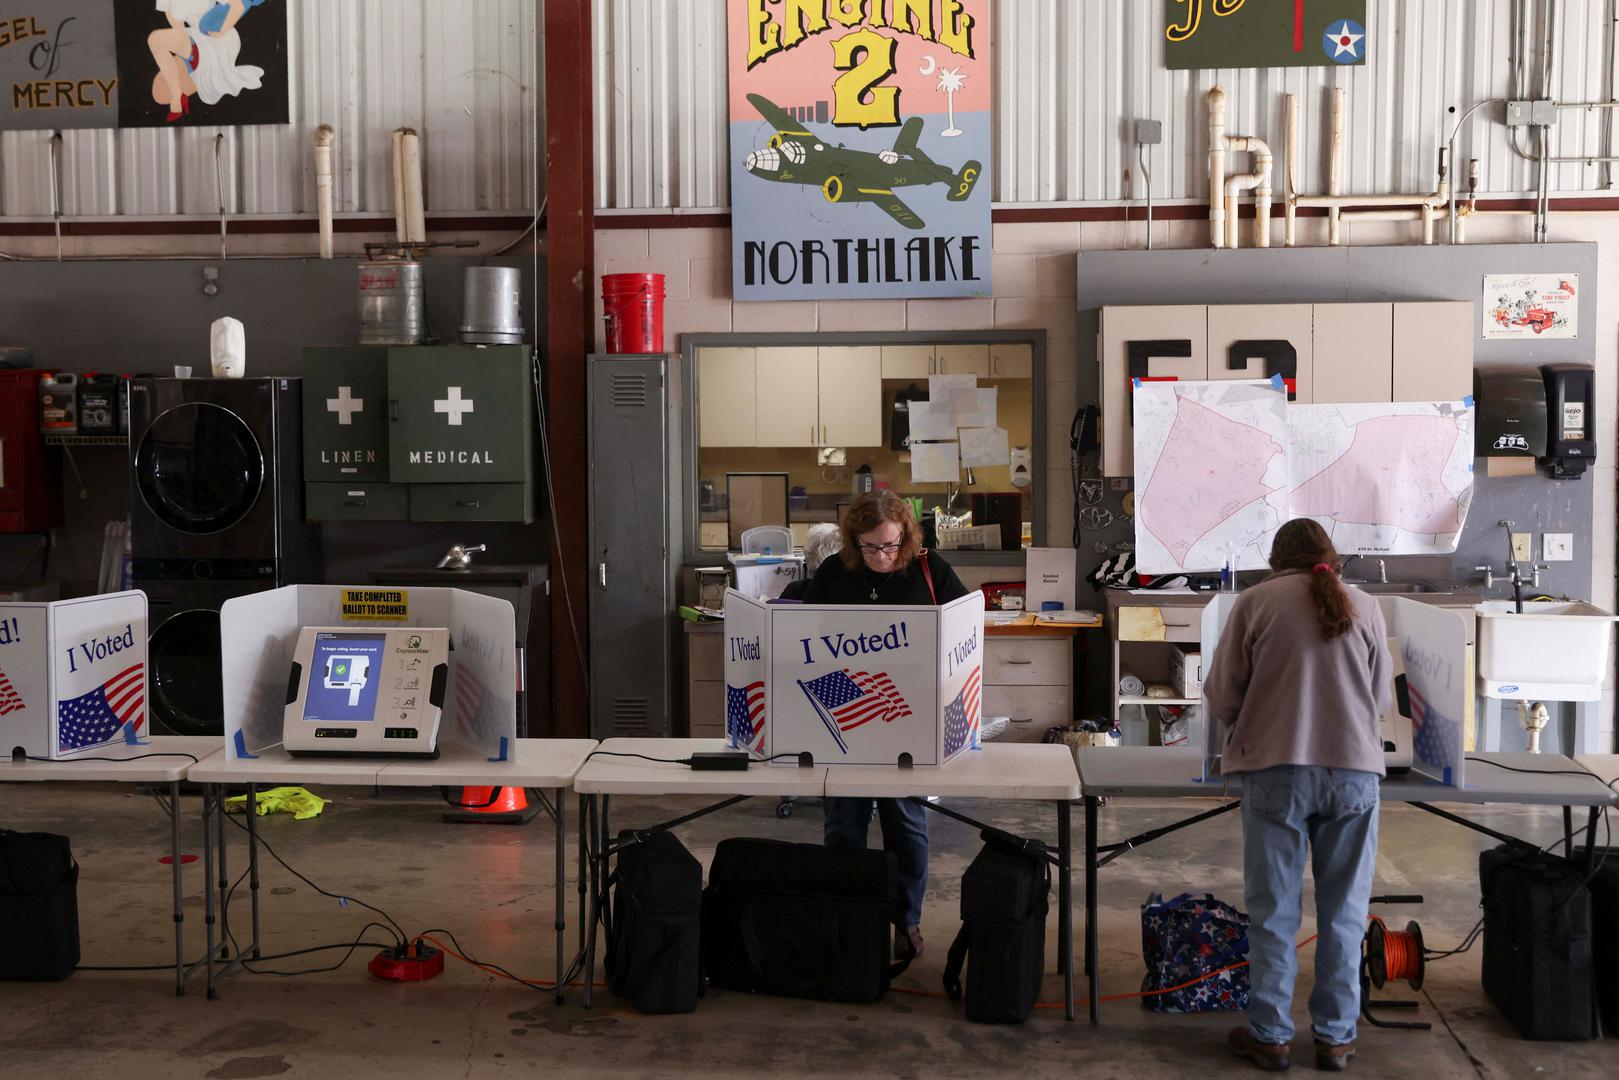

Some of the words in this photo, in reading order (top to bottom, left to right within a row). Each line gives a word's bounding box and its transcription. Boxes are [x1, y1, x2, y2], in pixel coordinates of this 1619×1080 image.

[29, 16, 77, 80] of
[747, 0, 976, 72] ENGINE
[12, 79, 117, 109] MERCY
[830, 27, 902, 131] 2
[743, 235, 982, 286] NORTHLAKE
[321, 450, 376, 463] LINEN
[409, 451, 494, 464] MEDICAL
[342, 604, 366, 615] BALLOT
[367, 605, 376, 615] TO
[376, 605, 407, 616] SCANNER
[347, 592, 364, 602] TAKE
[364, 592, 402, 603] COMPLETED
[66, 647, 78, 674] I
[80, 623, 135, 664] Voted
[730, 637, 736, 662] I
[736, 635, 761, 661] Voted
[800, 638, 816, 665] I
[820, 621, 910, 659] Voted!
[948, 652, 953, 676] I
[954, 626, 978, 669] Voted
